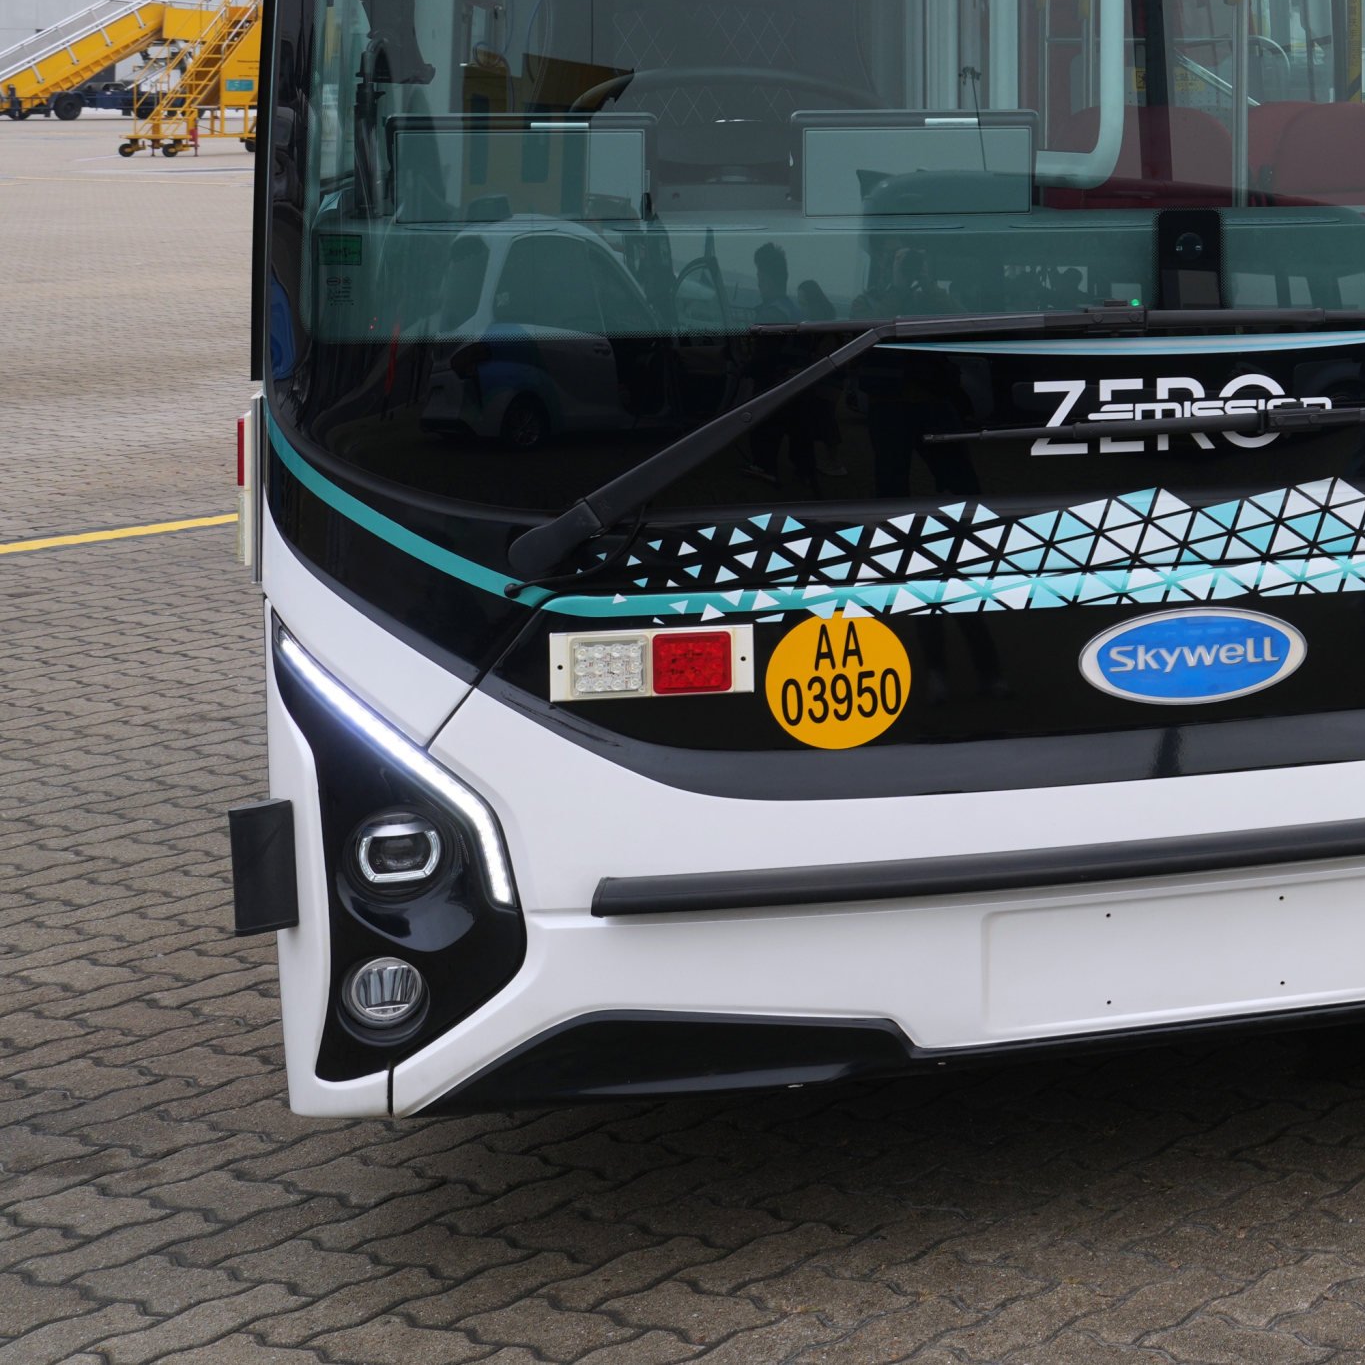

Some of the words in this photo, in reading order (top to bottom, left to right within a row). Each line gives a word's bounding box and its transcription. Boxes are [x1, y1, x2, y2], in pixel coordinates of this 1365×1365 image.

[1030, 374, 1286, 456] ZERO
[814, 620, 864, 671] AA
[1109, 636, 1280, 673] Skywell
[781, 667, 902, 727] 03950
